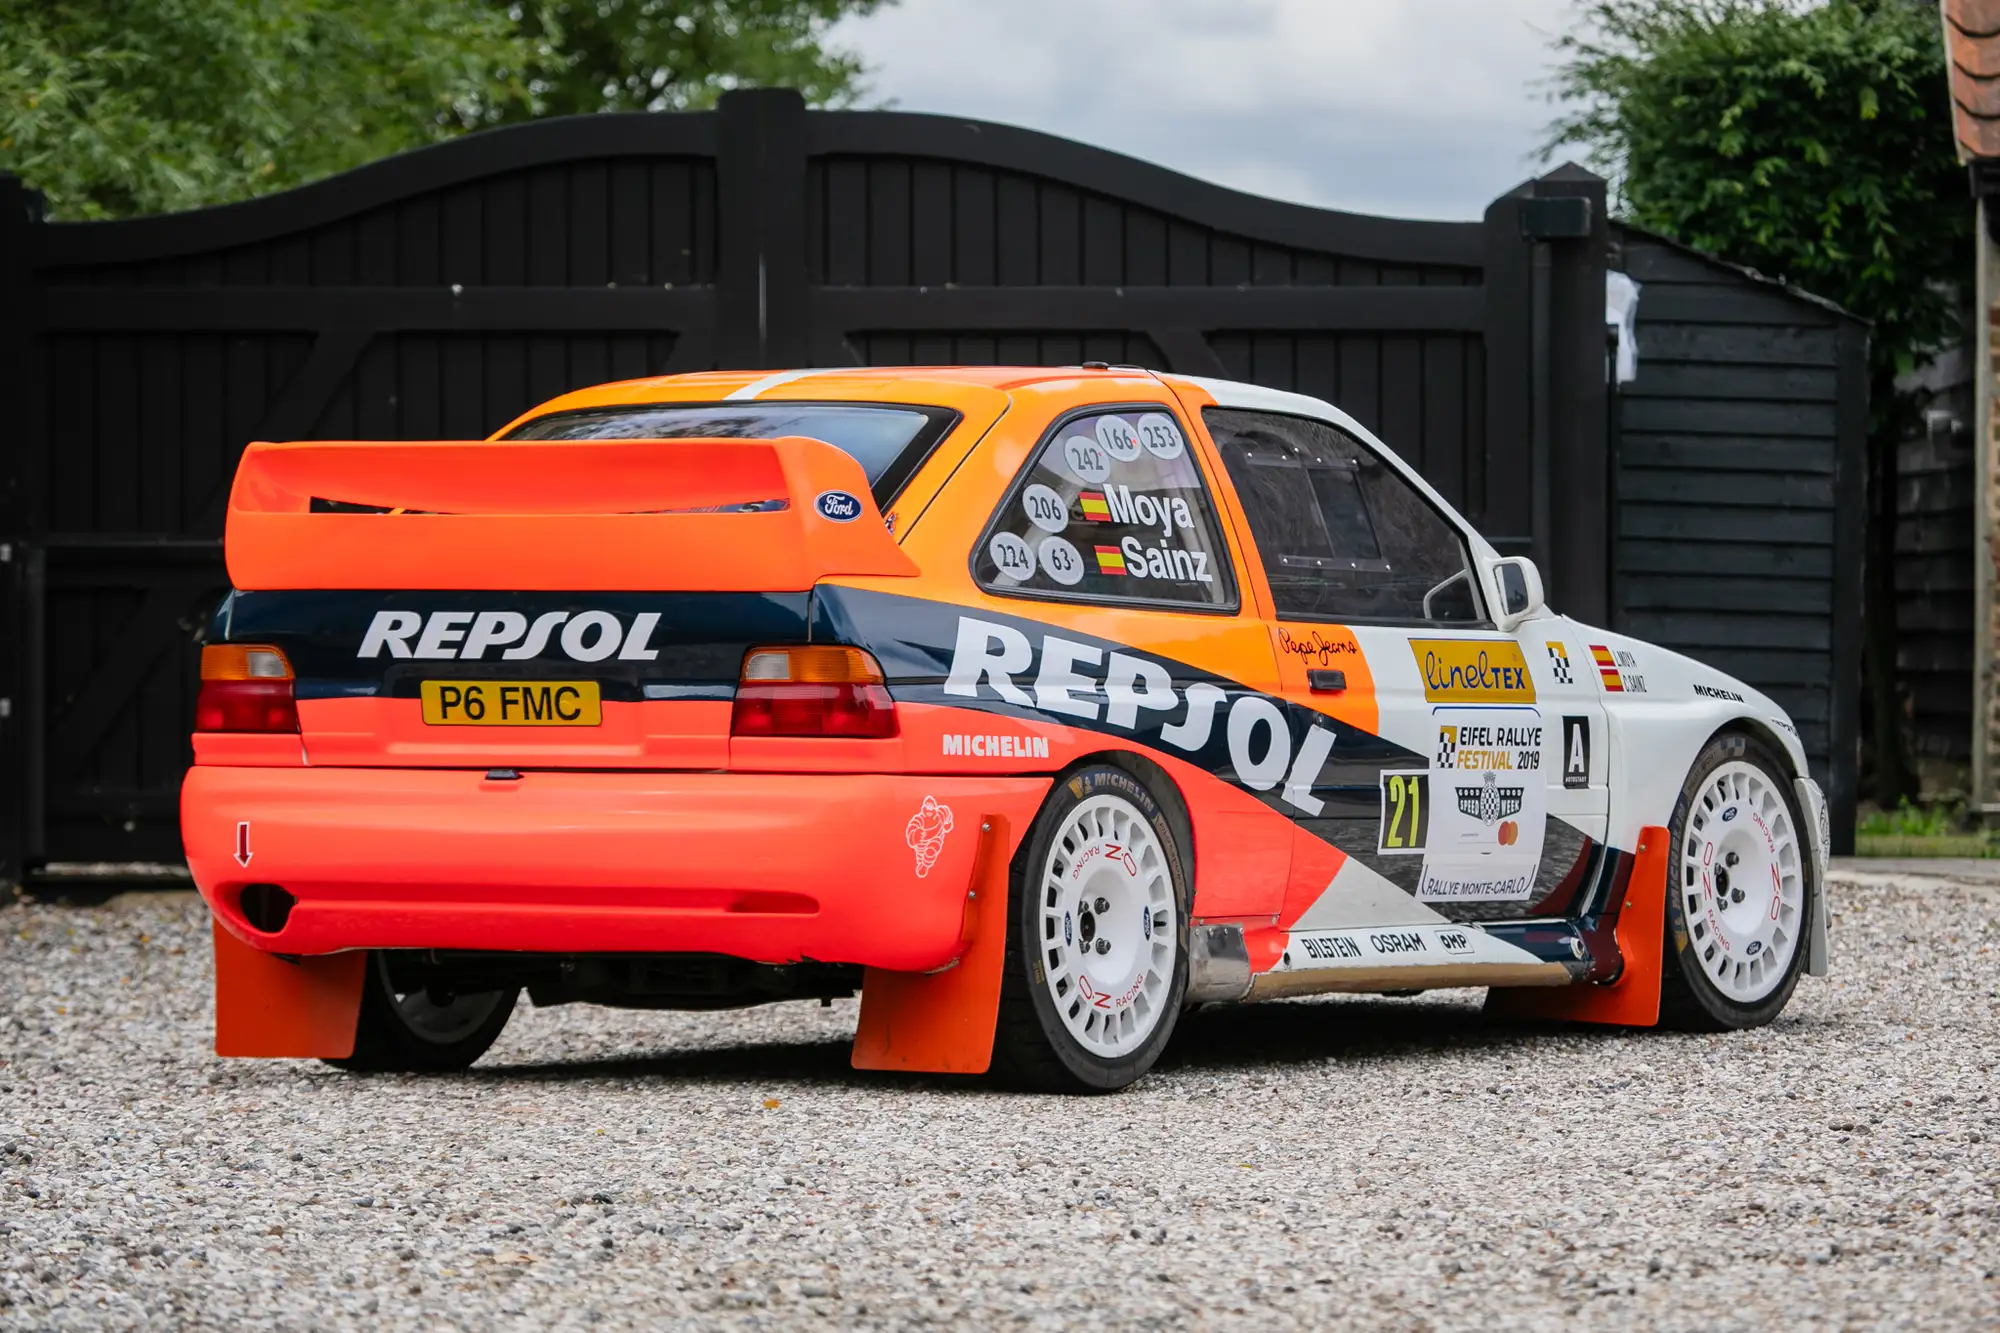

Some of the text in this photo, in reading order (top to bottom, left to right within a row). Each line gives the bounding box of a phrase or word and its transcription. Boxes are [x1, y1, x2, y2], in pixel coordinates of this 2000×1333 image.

[1103, 427, 1133, 450] 166
[1144, 426, 1176, 449] 253
[1072, 448, 1104, 471] 242
[825, 494, 854, 516] Ford
[1030, 496, 1062, 520] 206
[1103, 483, 1194, 537] Moya
[998, 544, 1029, 569] 224
[1052, 547, 1072, 571] 63
[1121, 536, 1213, 582] Sainz
[357, 611, 662, 661] REPSOL
[1279, 628, 1357, 666] Pepe Jeans
[441, 686, 581, 722] P6 FMC
[1693, 684, 1744, 703] MICHELIN
[943, 616, 1337, 816] REPSOL
[943, 734, 1049, 758] MICHELIN
[1460, 727, 1542, 746] EIFEL RALLYE
[1568, 723, 1585, 773] A
[1457, 750, 1540, 770] FESTIVAL 2019
[1094, 773, 1155, 812] MICHELIN
[1387, 775, 1419, 847] 21
[1460, 800, 1520, 816] SPEED WEEK
[1752, 812, 1776, 853] RACING
[1073, 845, 1100, 880] RACING
[1426, 876, 1524, 896] RALLYE MONTE-CARLO
[1707, 908, 1731, 951] RACING
[1301, 933, 1467, 959] BILSTEIN OSRAM OMP
[1115, 973, 1144, 1008] RACING
